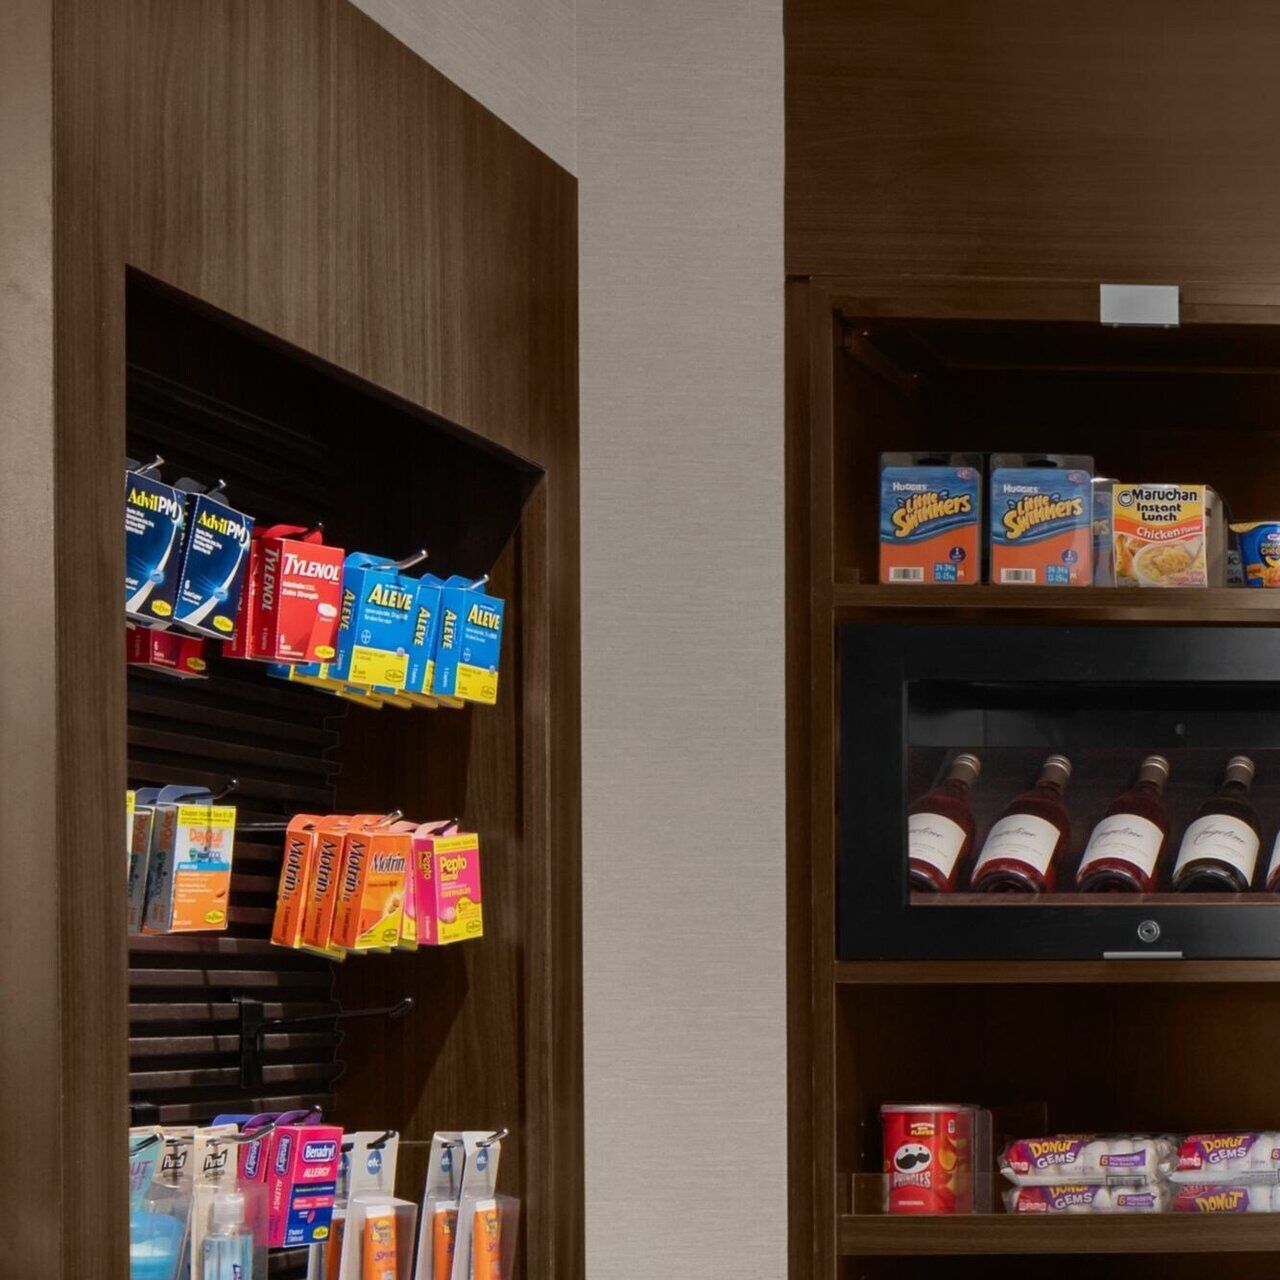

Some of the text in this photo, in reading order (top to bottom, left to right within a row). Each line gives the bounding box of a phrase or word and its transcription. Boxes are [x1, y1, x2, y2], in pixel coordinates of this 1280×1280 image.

[1132, 488, 1197, 501] Maruchan
[1136, 502, 1182, 513] Instant
[1141, 512, 1177, 522] Lunch
[1137, 526, 1180, 539] Chicken
[284, 553, 340, 581] TYLENOL
[262, 548, 279, 612] TYLENOL
[368, 584, 413, 610] ALEVE
[340, 589, 355, 630] ALEVE
[467, 603, 500, 630] ALEVE
[414, 607, 430, 646] ALEVE
[443, 609, 456, 649] ALEVE
[283, 840, 305, 895] Motrin
[316, 839, 337, 894] Motrin
[345, 839, 366, 895] Motrin
[370, 853, 405, 873] Motrin
[440, 857, 466, 873] Pepto
[305, 1144, 335, 1160] Benadryl
[1030, 1139, 1078, 1156] DONUT
[1202, 1136, 1249, 1152] DONUT
[276, 1137, 289, 1173] Benadryl
[1036, 1153, 1075, 1169] GEMS
[1208, 1148, 1246, 1164] GEMS
[303, 1167, 331, 1177] ALLERGY
[893, 1172, 931, 1187] PRINGLES
[1054, 1192, 1093, 1209] GEMS
[1196, 1191, 1244, 1212] DONUT
